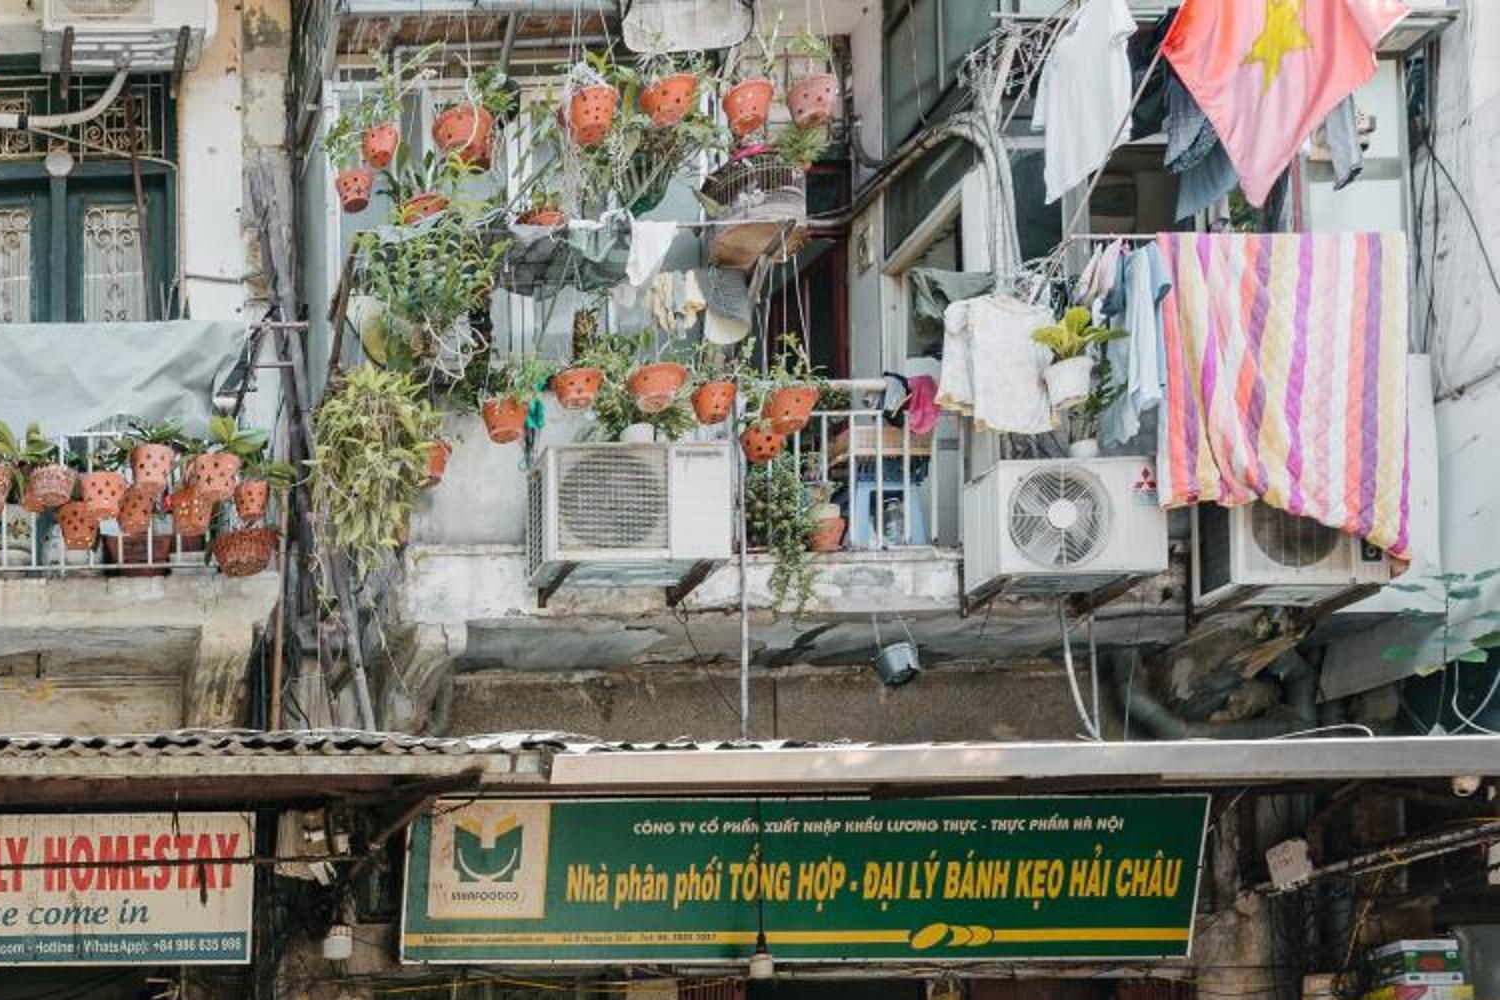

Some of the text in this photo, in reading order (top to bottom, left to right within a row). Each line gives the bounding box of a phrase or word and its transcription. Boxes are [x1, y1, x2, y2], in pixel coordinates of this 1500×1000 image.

[633, 819, 676, 835] CÔNG
[679, 821, 695, 834] TY
[699, 815, 719, 834] CỔ
[763, 816, 800, 834] XUẤT
[803, 818, 841, 837] NHẬP
[845, 815, 884, 834] KHẨU
[887, 818, 939, 833] LƯƠNG
[942, 818, 978, 836] THỰC
[990, 818, 1025, 835] THỰC
[1028, 812, 1070, 832] PHẨM
[1073, 815, 1093, 831] HÀ
[1096, 814, 1125, 833] NỘI
[43, 832, 241, 892] HOMESTAY
[566, 841, 1184, 913] Nhà phân phối TỔNG HỢP - ĐẠI LÝ BÁNH KẸO HẢI CHÂU
[27, 903, 109, 926] come
[118, 899, 150, 925] in
